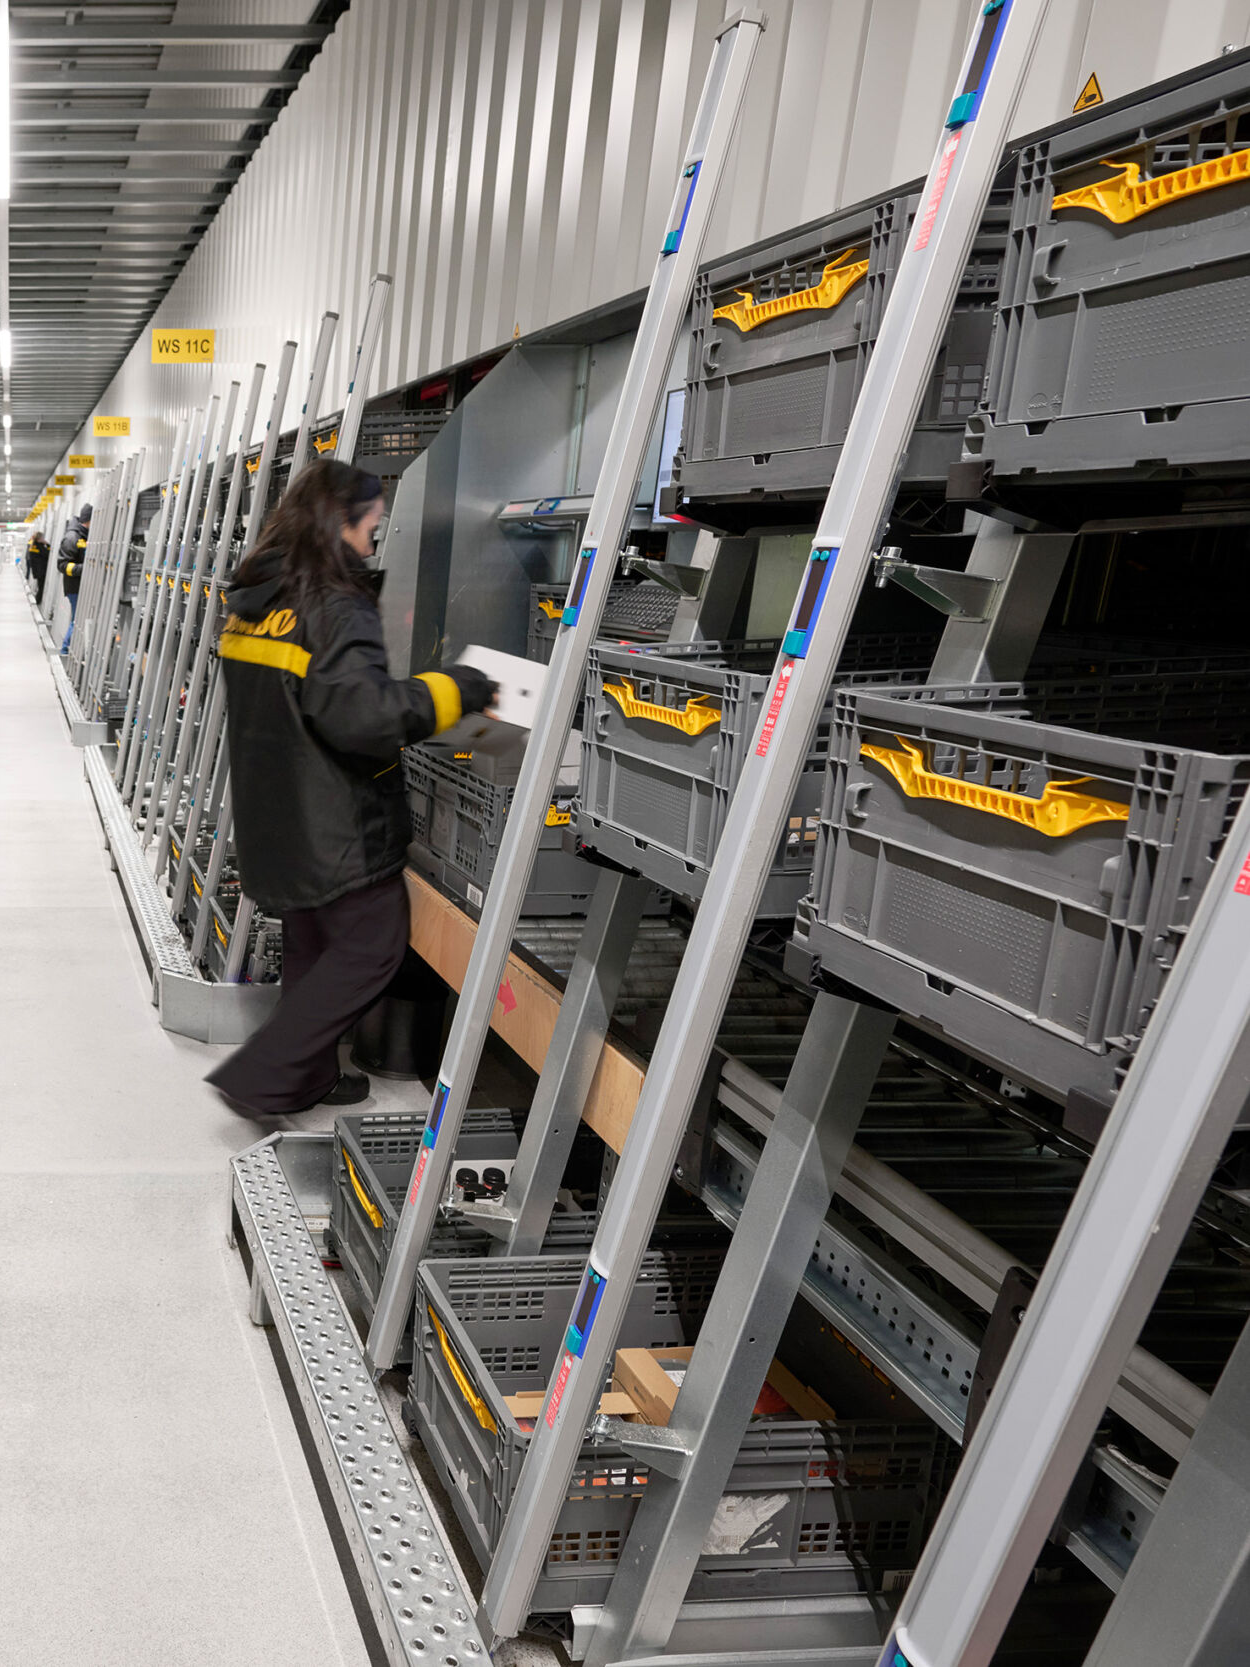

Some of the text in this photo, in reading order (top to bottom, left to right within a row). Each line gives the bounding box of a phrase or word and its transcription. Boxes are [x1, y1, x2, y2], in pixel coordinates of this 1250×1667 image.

[158, 339, 210, 353] WS 11C
[96, 421, 128, 431] WS 11B
